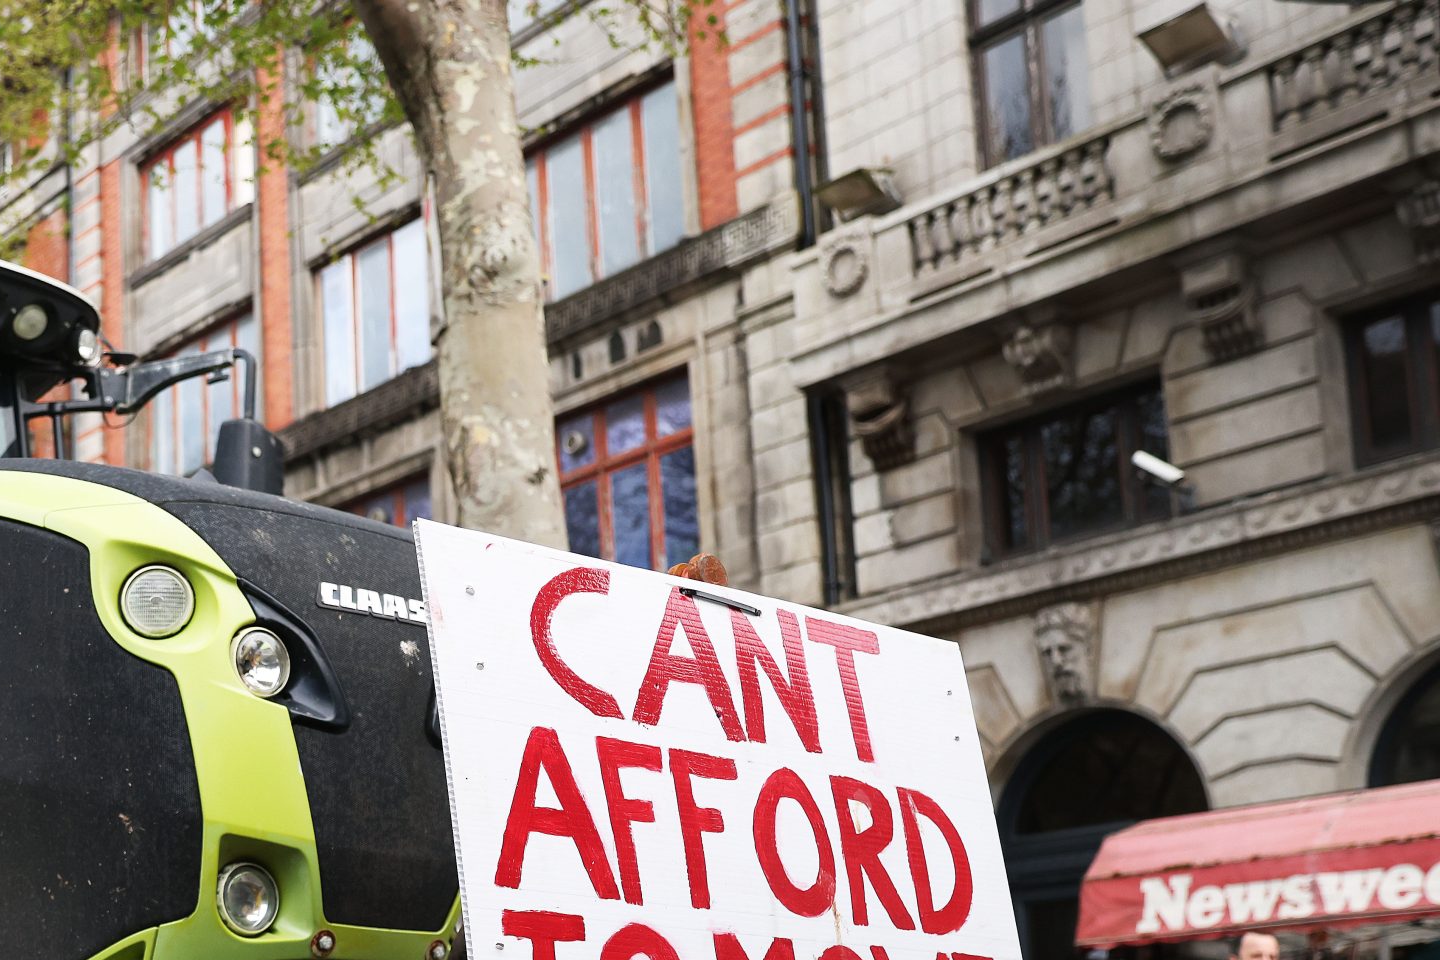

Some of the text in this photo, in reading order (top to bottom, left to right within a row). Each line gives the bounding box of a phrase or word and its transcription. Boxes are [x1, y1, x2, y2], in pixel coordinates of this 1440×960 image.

[319, 581, 426, 624] CLAAS
[530, 567, 880, 762] CANT
[494, 726, 973, 935] AFFORD
